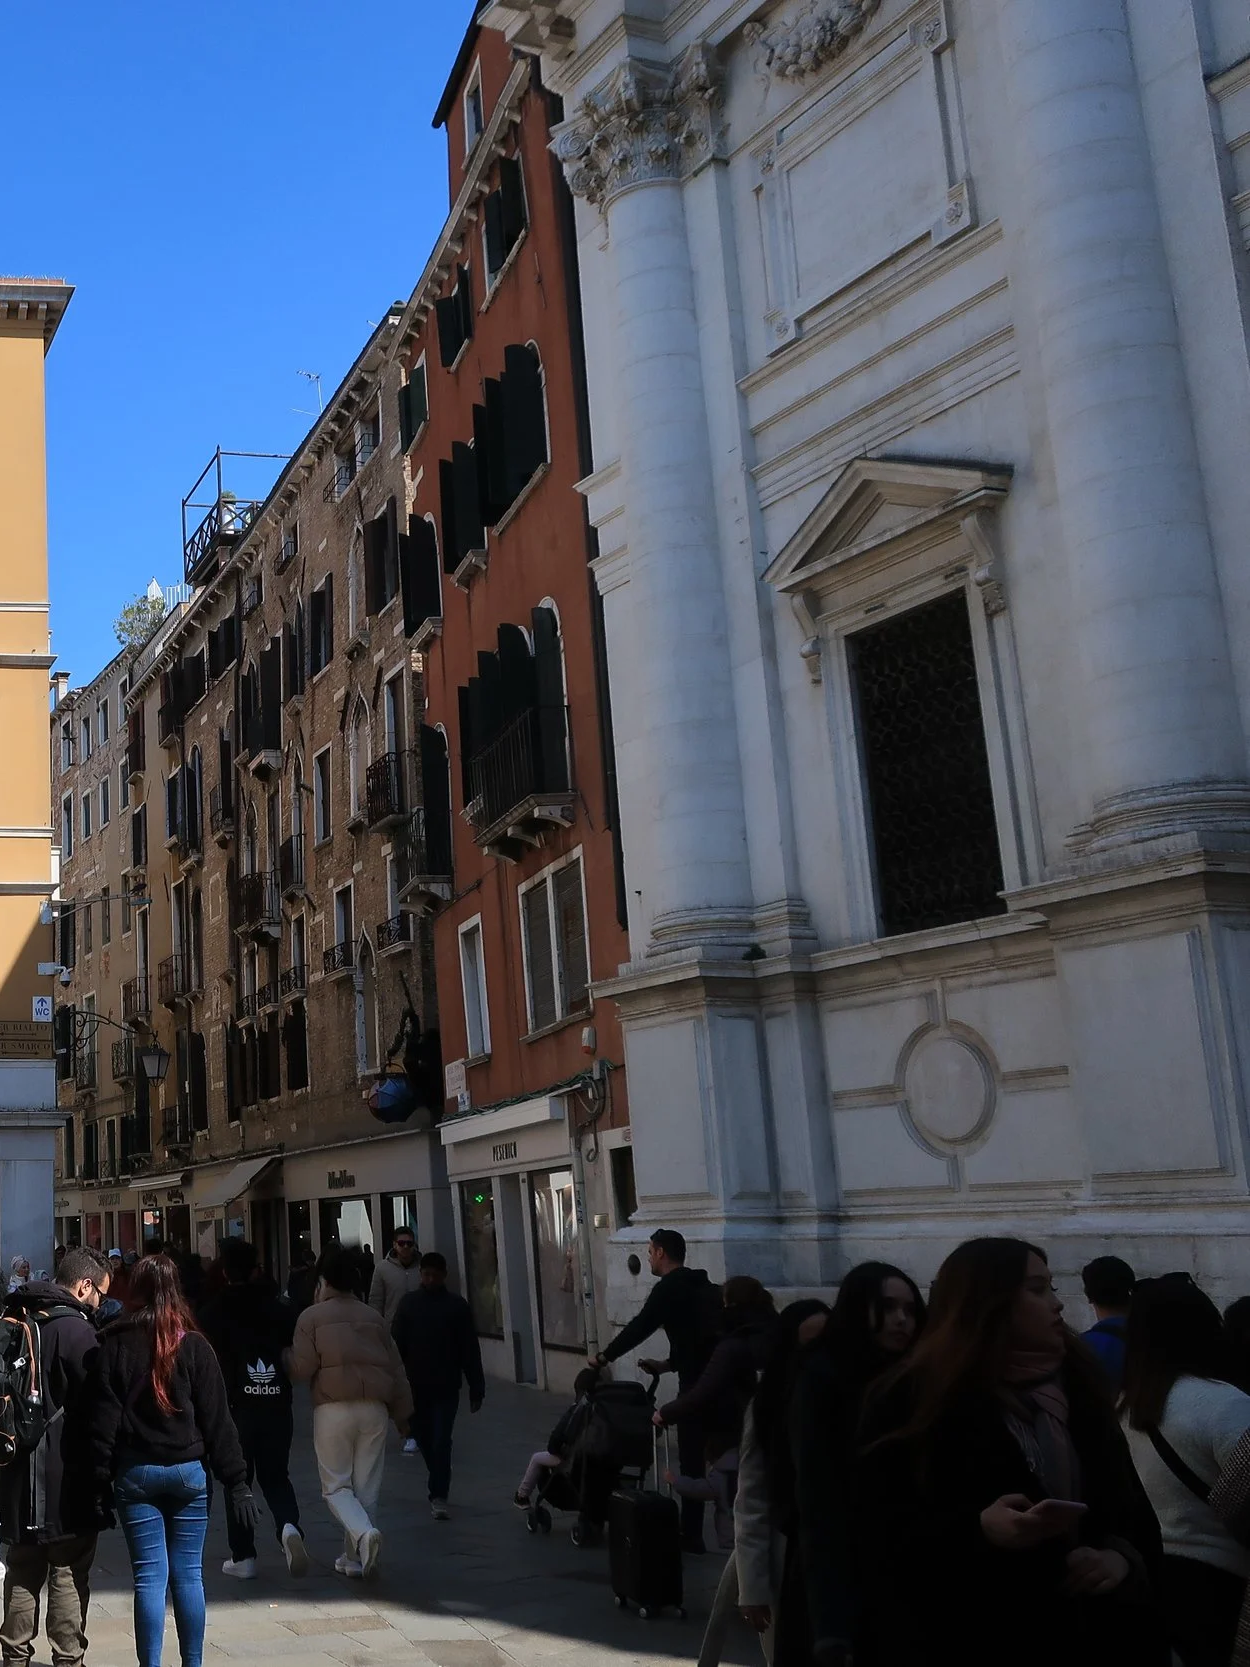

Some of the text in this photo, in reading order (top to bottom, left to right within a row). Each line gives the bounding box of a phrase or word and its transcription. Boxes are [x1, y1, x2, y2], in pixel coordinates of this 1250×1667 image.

[35, 1007, 50, 1016] WC
[13, 1023, 48, 1031] RIALTO
[244, 1384, 281, 1395] adidas
